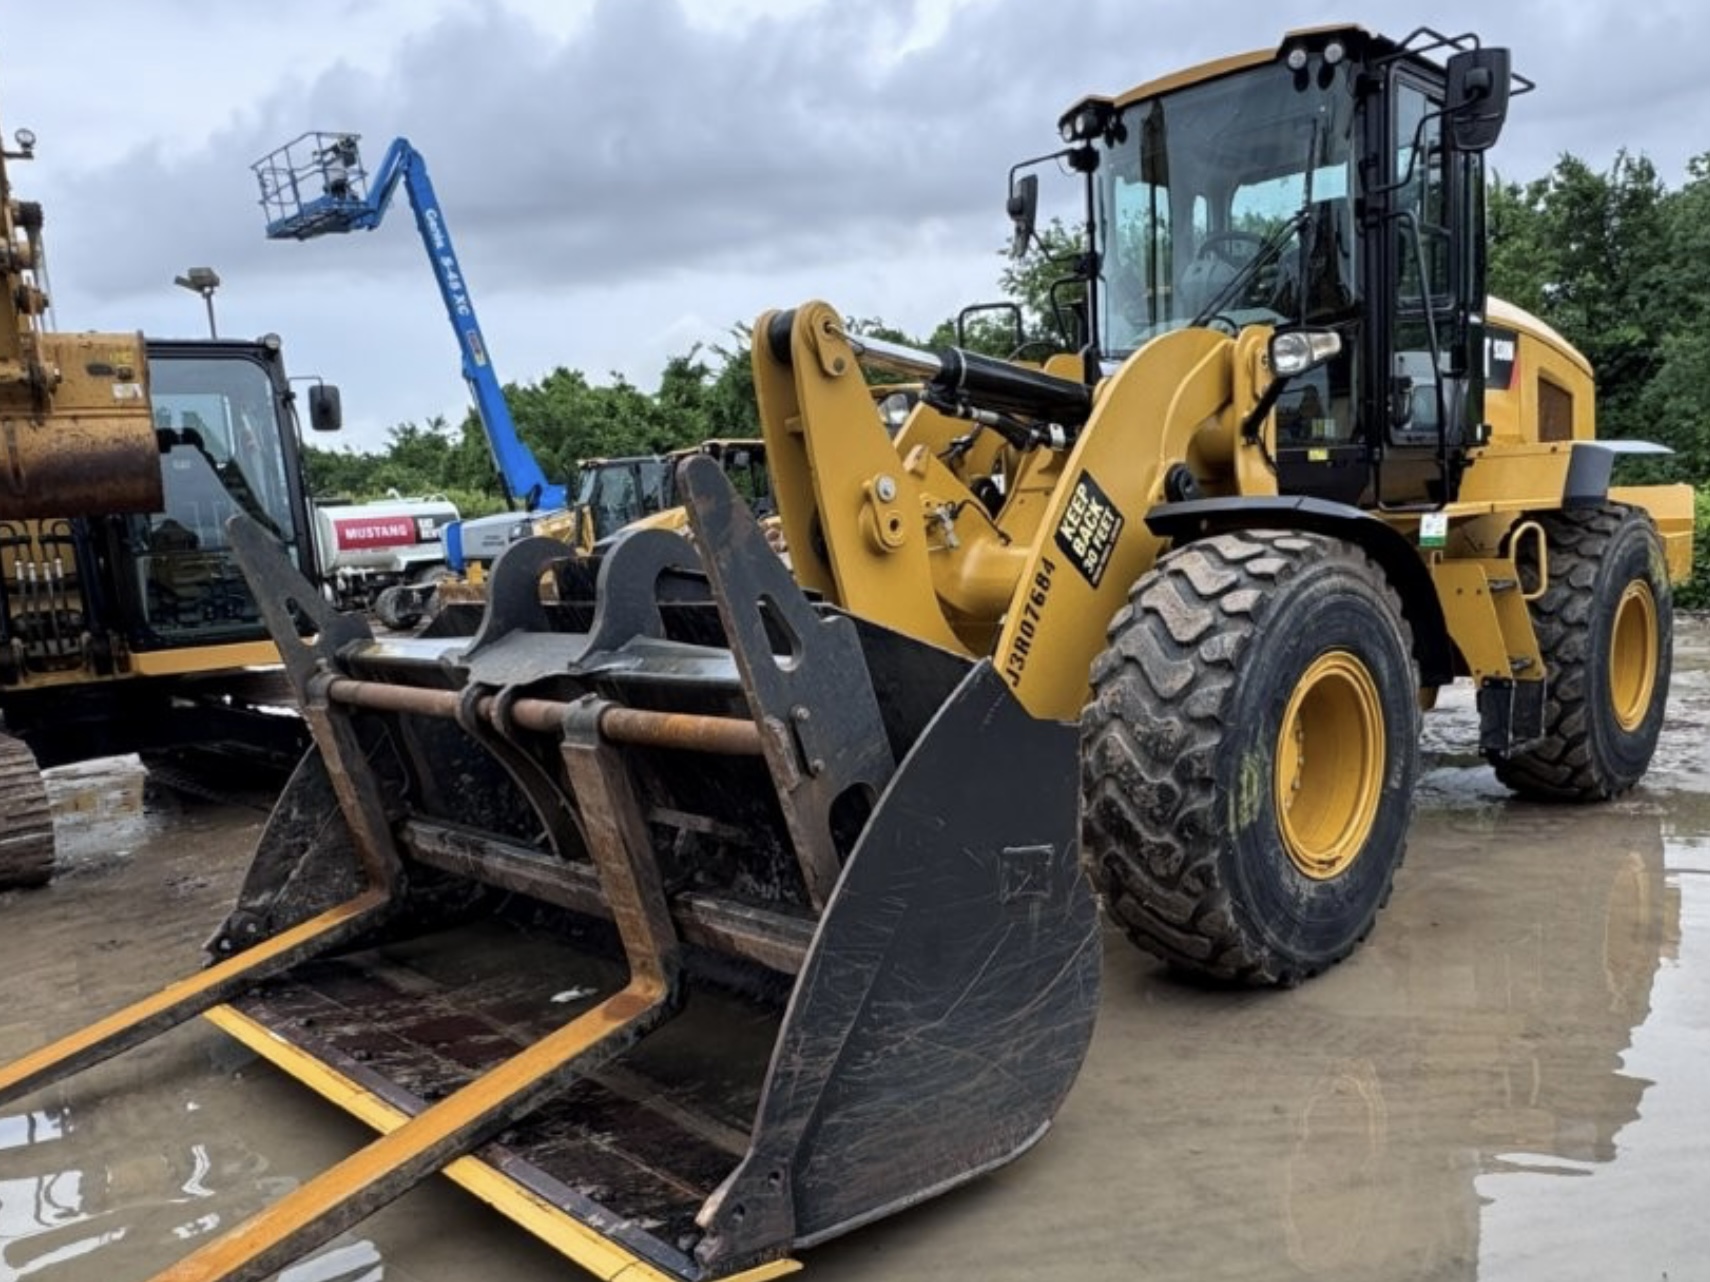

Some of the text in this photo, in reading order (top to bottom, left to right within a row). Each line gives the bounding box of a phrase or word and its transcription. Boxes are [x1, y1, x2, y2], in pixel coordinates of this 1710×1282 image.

[453, 294, 470, 317] XC
[345, 524, 408, 540] MUSTANG
[1060, 482, 1088, 541] KEEP
[1072, 496, 1104, 558] BACK
[1082, 548, 1098, 575] 30
[1092, 506, 1115, 550] FEET
